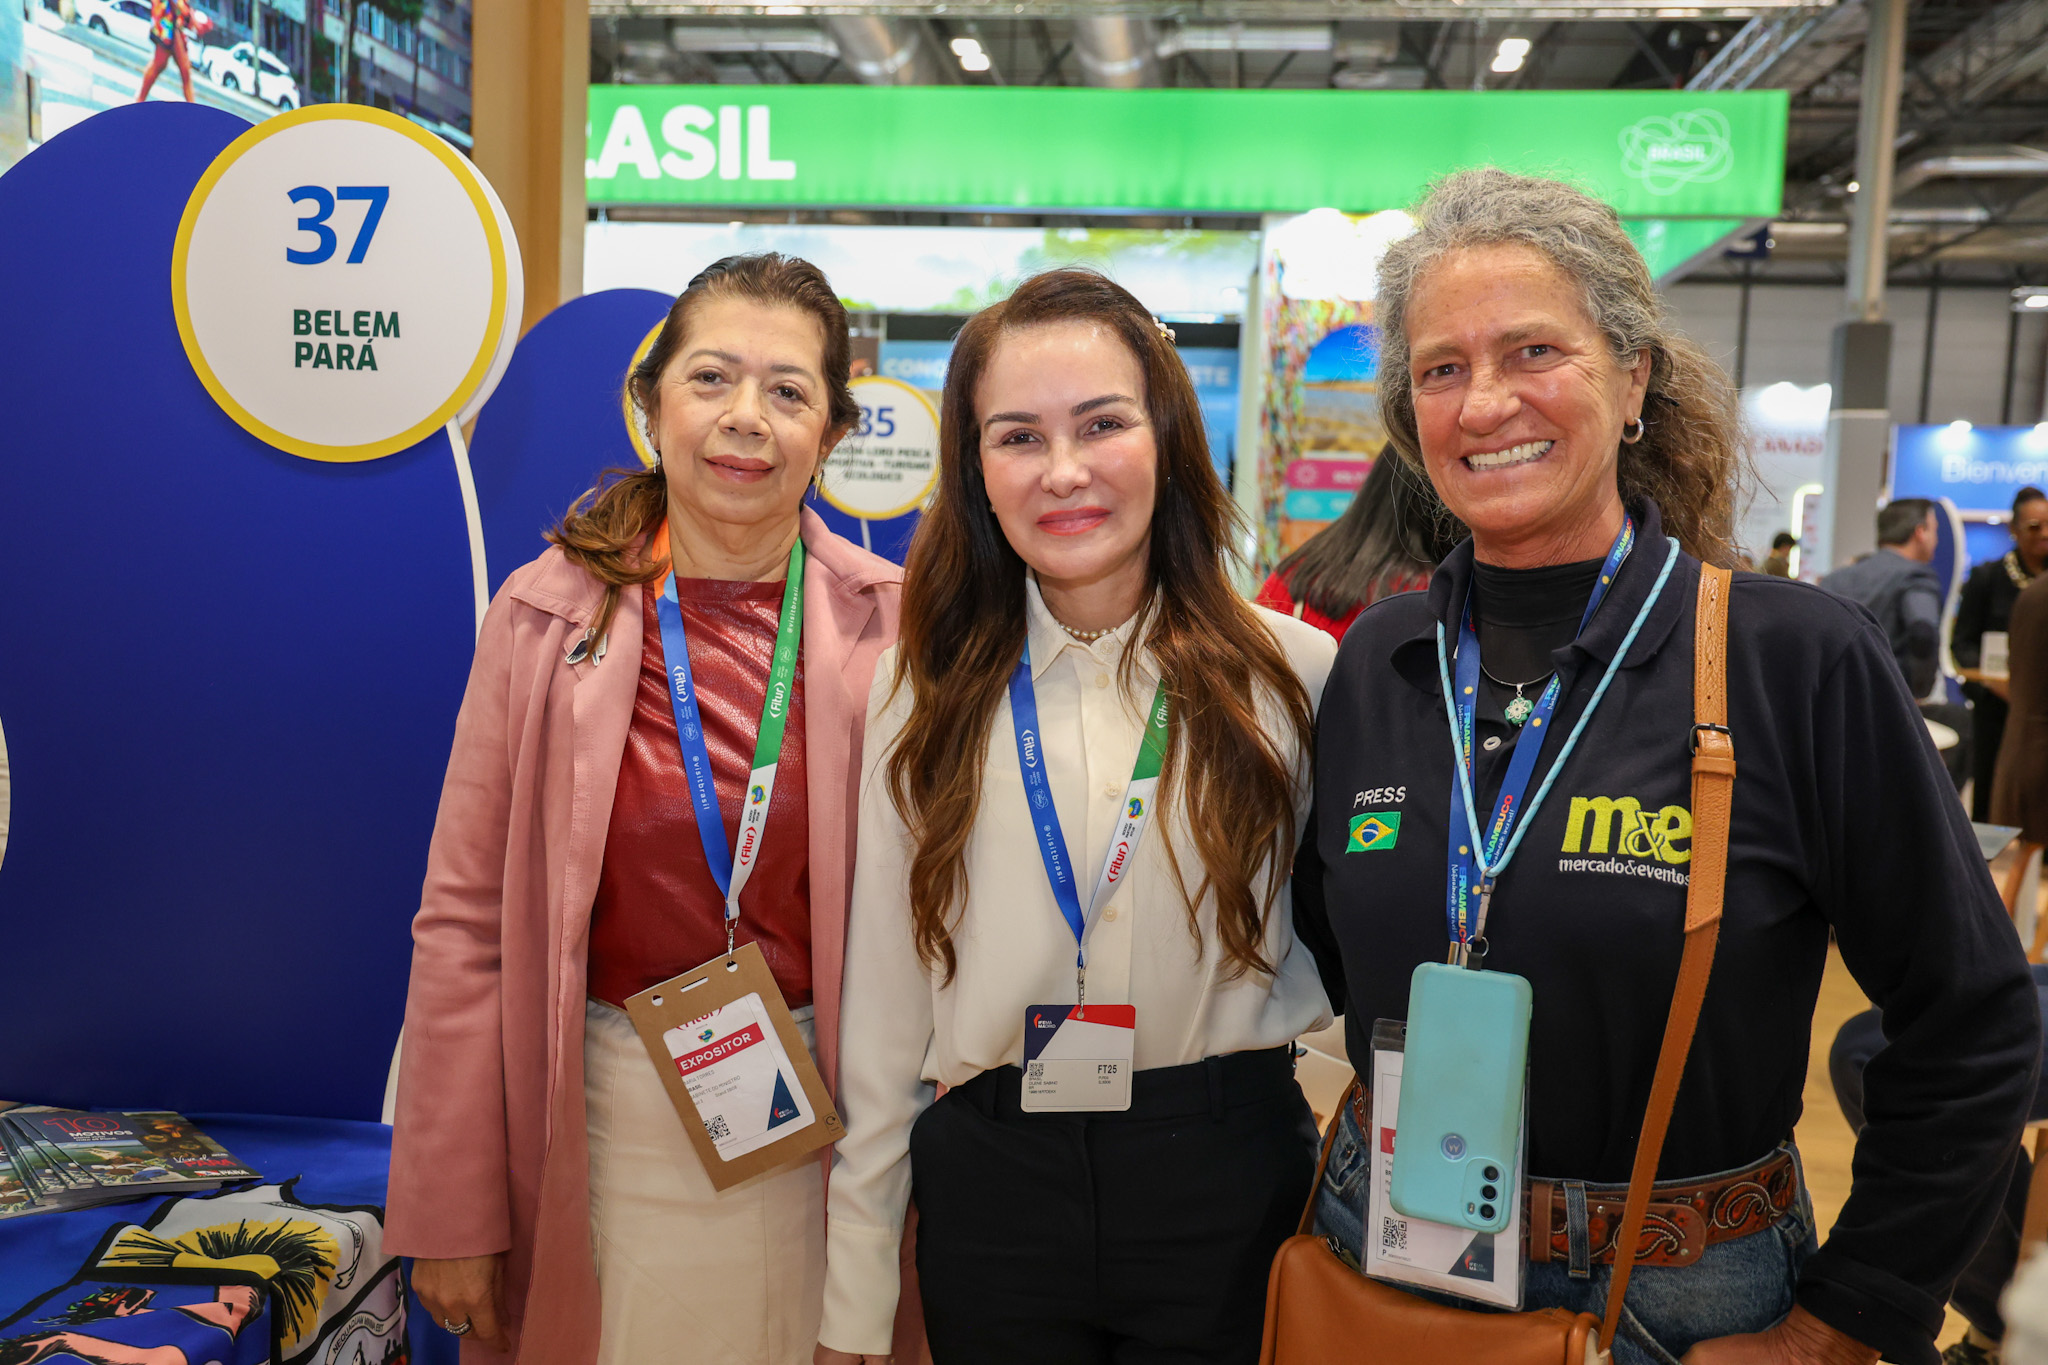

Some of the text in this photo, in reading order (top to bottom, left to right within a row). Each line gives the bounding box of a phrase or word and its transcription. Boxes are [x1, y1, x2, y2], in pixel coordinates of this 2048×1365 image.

[585, 104, 796, 180] ASIL
[287, 185, 389, 265] 37
[293, 308, 400, 338] BELEM
[294, 338, 378, 371] PARÁ
[787, 586, 800, 634] @visitbrasil
[692, 755, 711, 811] @visitbrasil
[1352, 786, 1407, 809] PRESS
[1560, 795, 1693, 864] m&e
[1043, 824, 1067, 884] @visitbrasil
[1558, 857, 1690, 887] mercado&eventos
[680, 1032, 752, 1071] EXPOSITOR
[1097, 1064, 1118, 1074] FT25
[691, 1087, 713, 1099] ABINETE
[43, 1117, 121, 1133] 10
[68, 1130, 134, 1138] MOTIVOS
